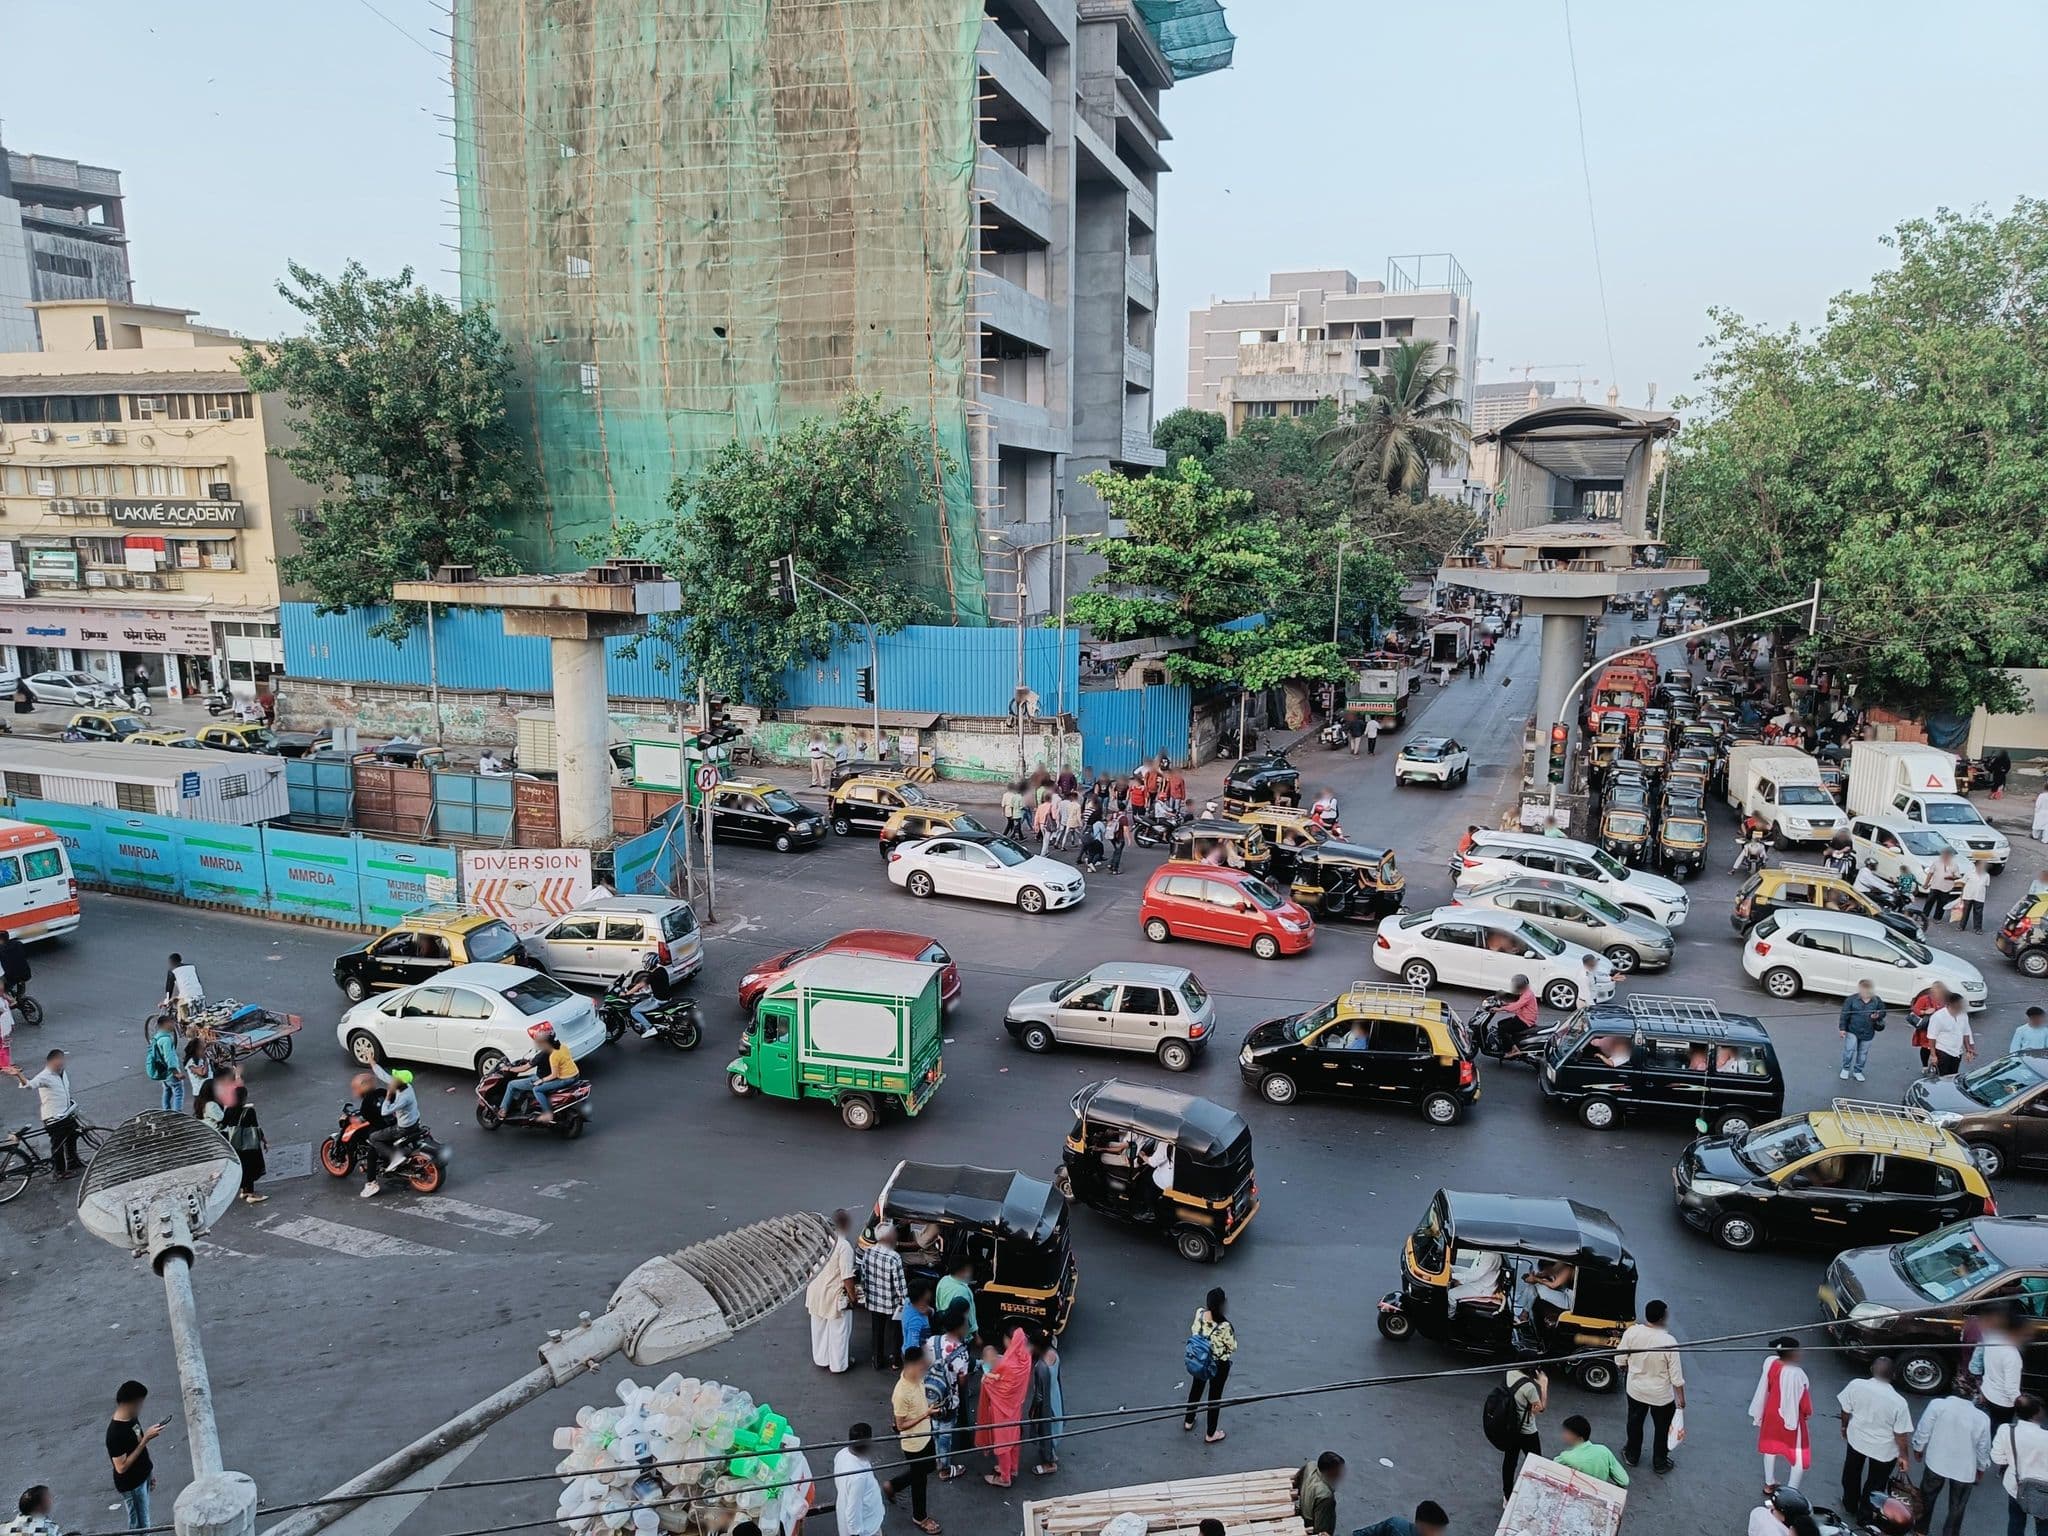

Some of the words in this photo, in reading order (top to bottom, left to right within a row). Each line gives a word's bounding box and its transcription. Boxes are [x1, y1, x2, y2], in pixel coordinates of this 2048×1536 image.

[114, 503, 165, 520] LAKMÉ
[168, 506, 237, 521] ACADEMY
[119, 843, 159, 860] MMRDA
[200, 854, 243, 873] MMRDA
[474, 855, 578, 870] DIVERSION
[288, 867, 336, 886] MMRDA
[389, 890, 424, 903] METRO
